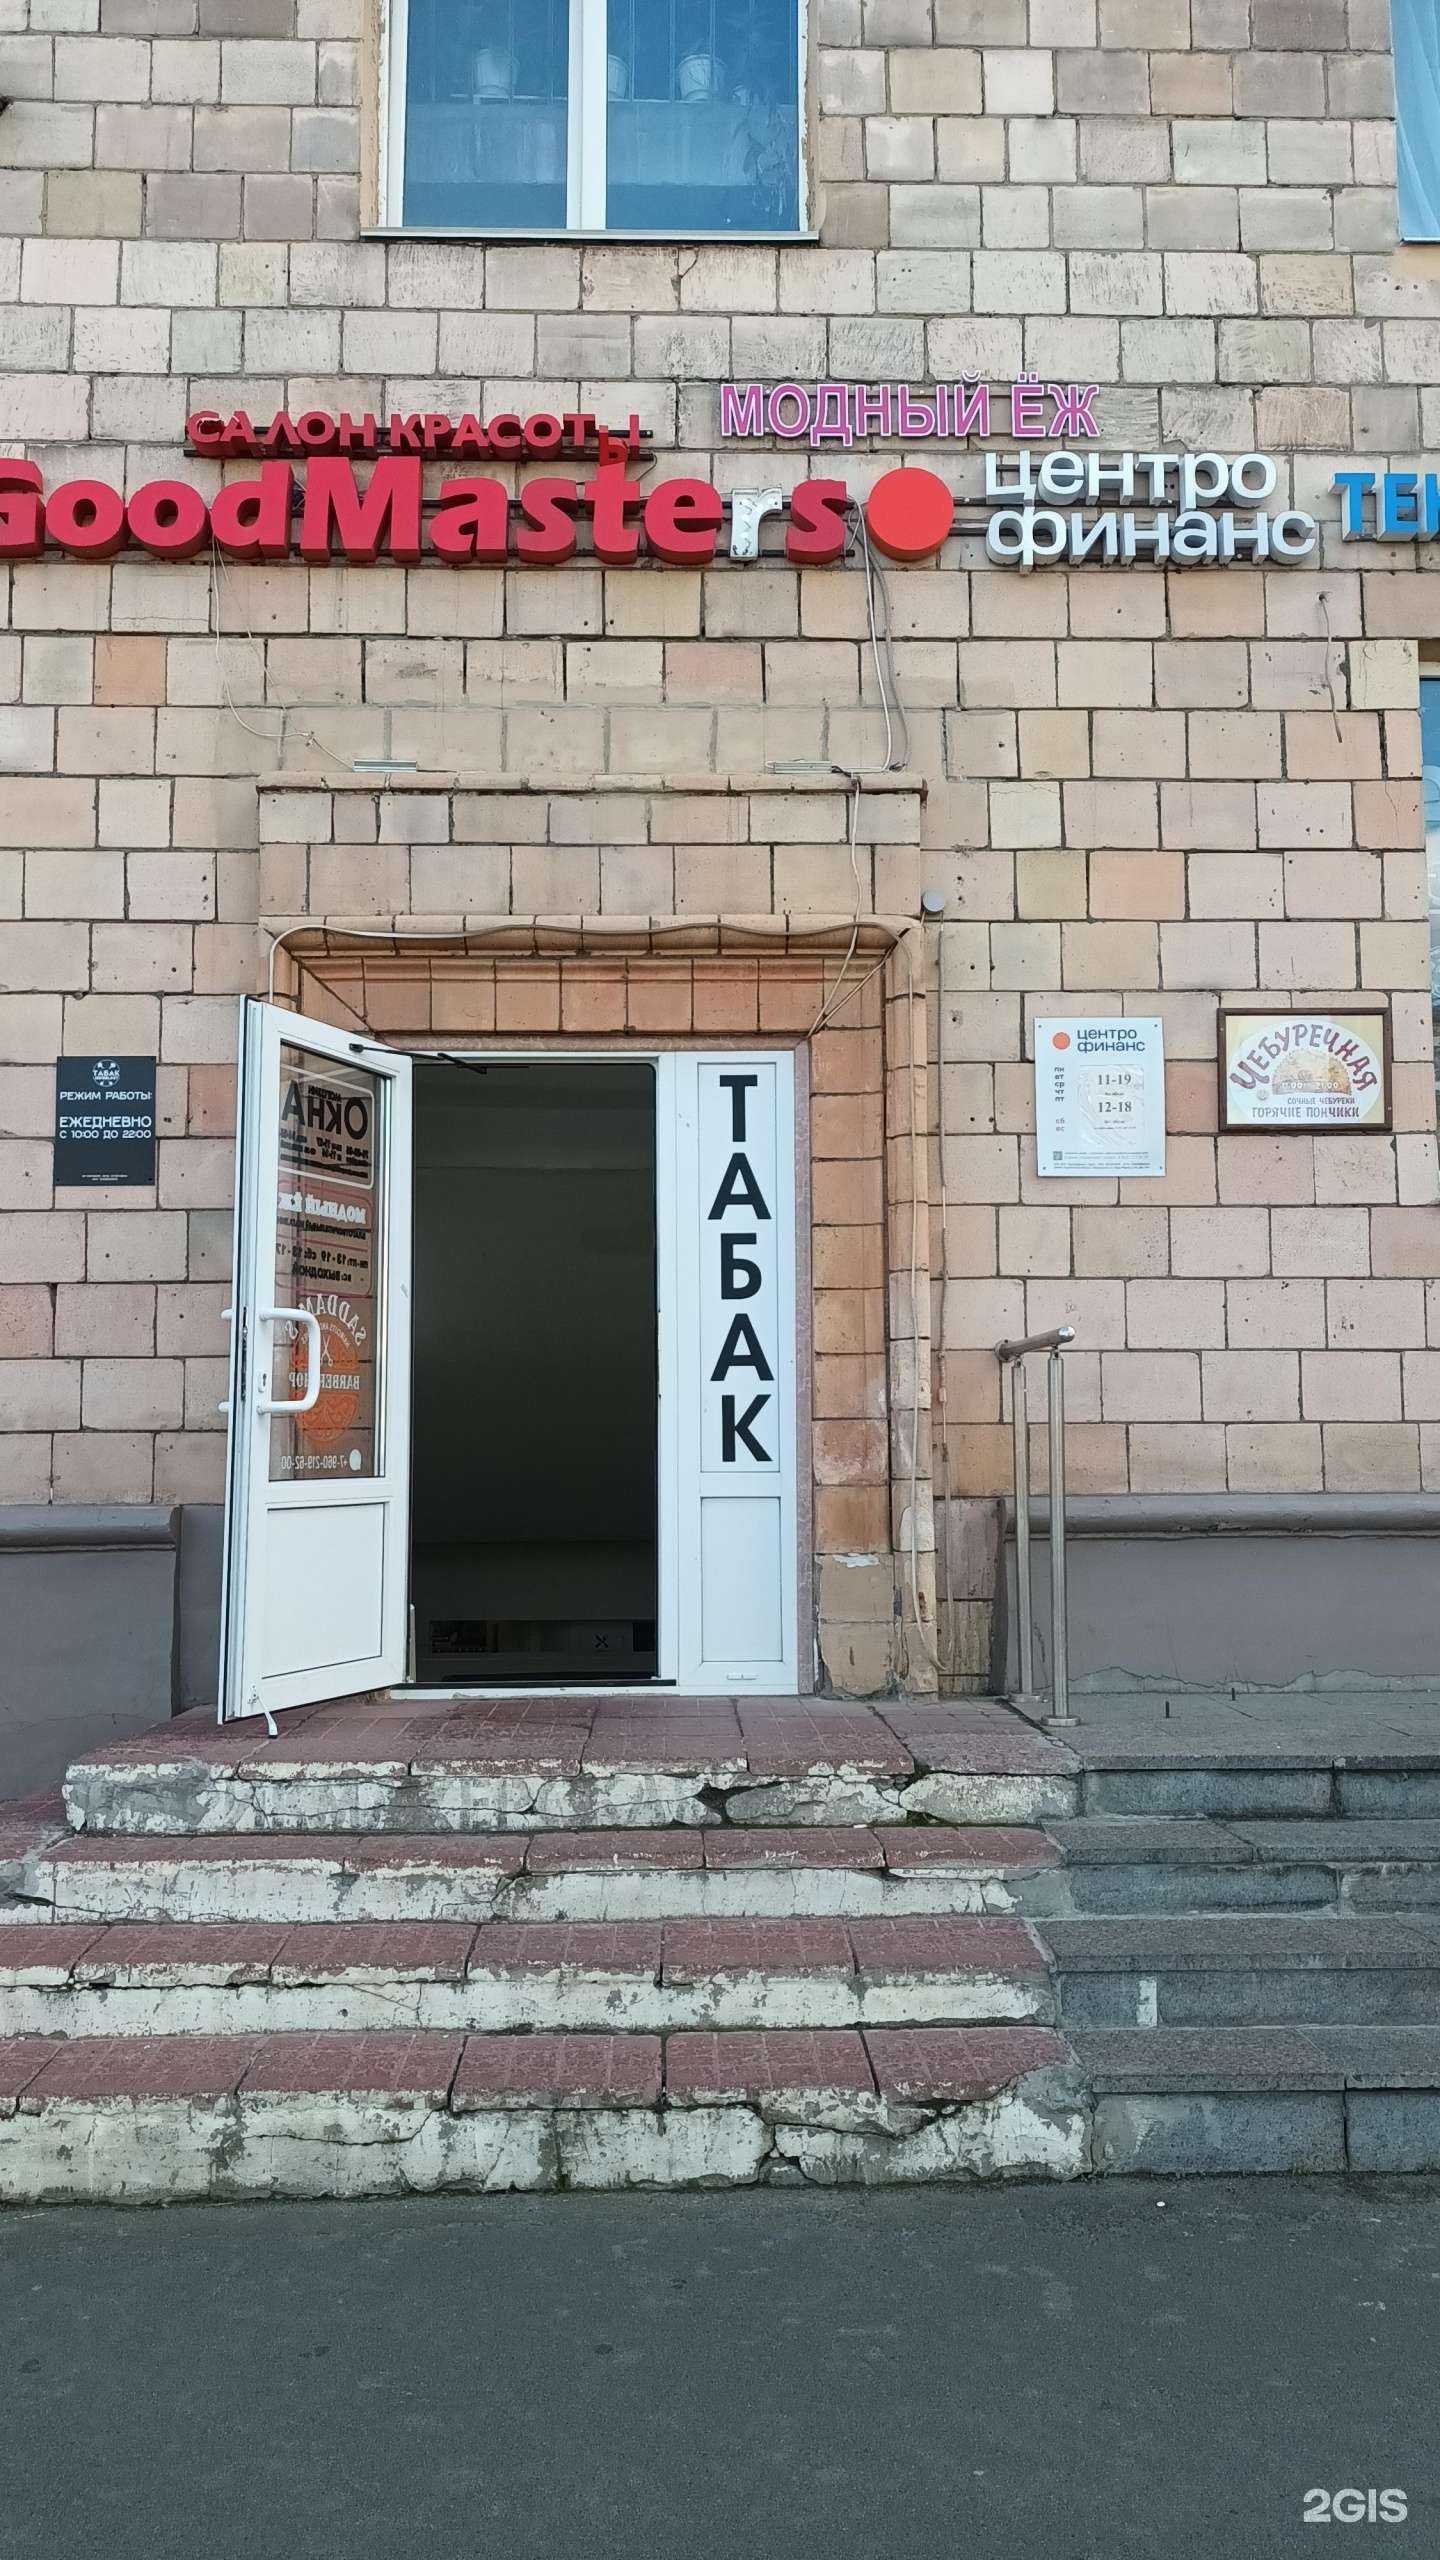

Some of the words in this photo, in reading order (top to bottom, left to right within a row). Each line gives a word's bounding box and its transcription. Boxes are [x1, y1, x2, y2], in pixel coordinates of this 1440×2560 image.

[720, 370, 990, 447] МОДНЫЙ
[1011, 372, 1100, 438] ЁЖ
[185, 411, 376, 456] САЛОН
[389, 412, 640, 458] КРАСОТЫ
[985, 450, 1277, 509] центро
[985, 505, 1317, 568] финанс
[1077, 1028, 1137, 1041] центро
[1077, 1040, 1146, 1054] финанс
[1229, 1023, 1378, 1091] ЧЕБУРЕЧНАЯ
[1098, 1074, 1132, 1085] 11-19
[60, 1091, 101, 1100] РЕЖИМ
[1319, 1097, 1355, 1105] ЧЕБУРЕКИ
[1098, 1101, 1132, 1113] 12-18
[1252, 1107, 1301, 1118] ГОРЯЧИЕ
[1306, 1106, 1360, 1118] ПОНЧИКИ
[59, 1116, 152, 1129] ЕЖЕДНЕВНО
[71, 1130, 99, 1139] 10:00
[103, 1130, 118, 1140] ДО
[122, 1130, 152, 1139] 22:00
[707, 1074, 775, 1462] ТАБАК
